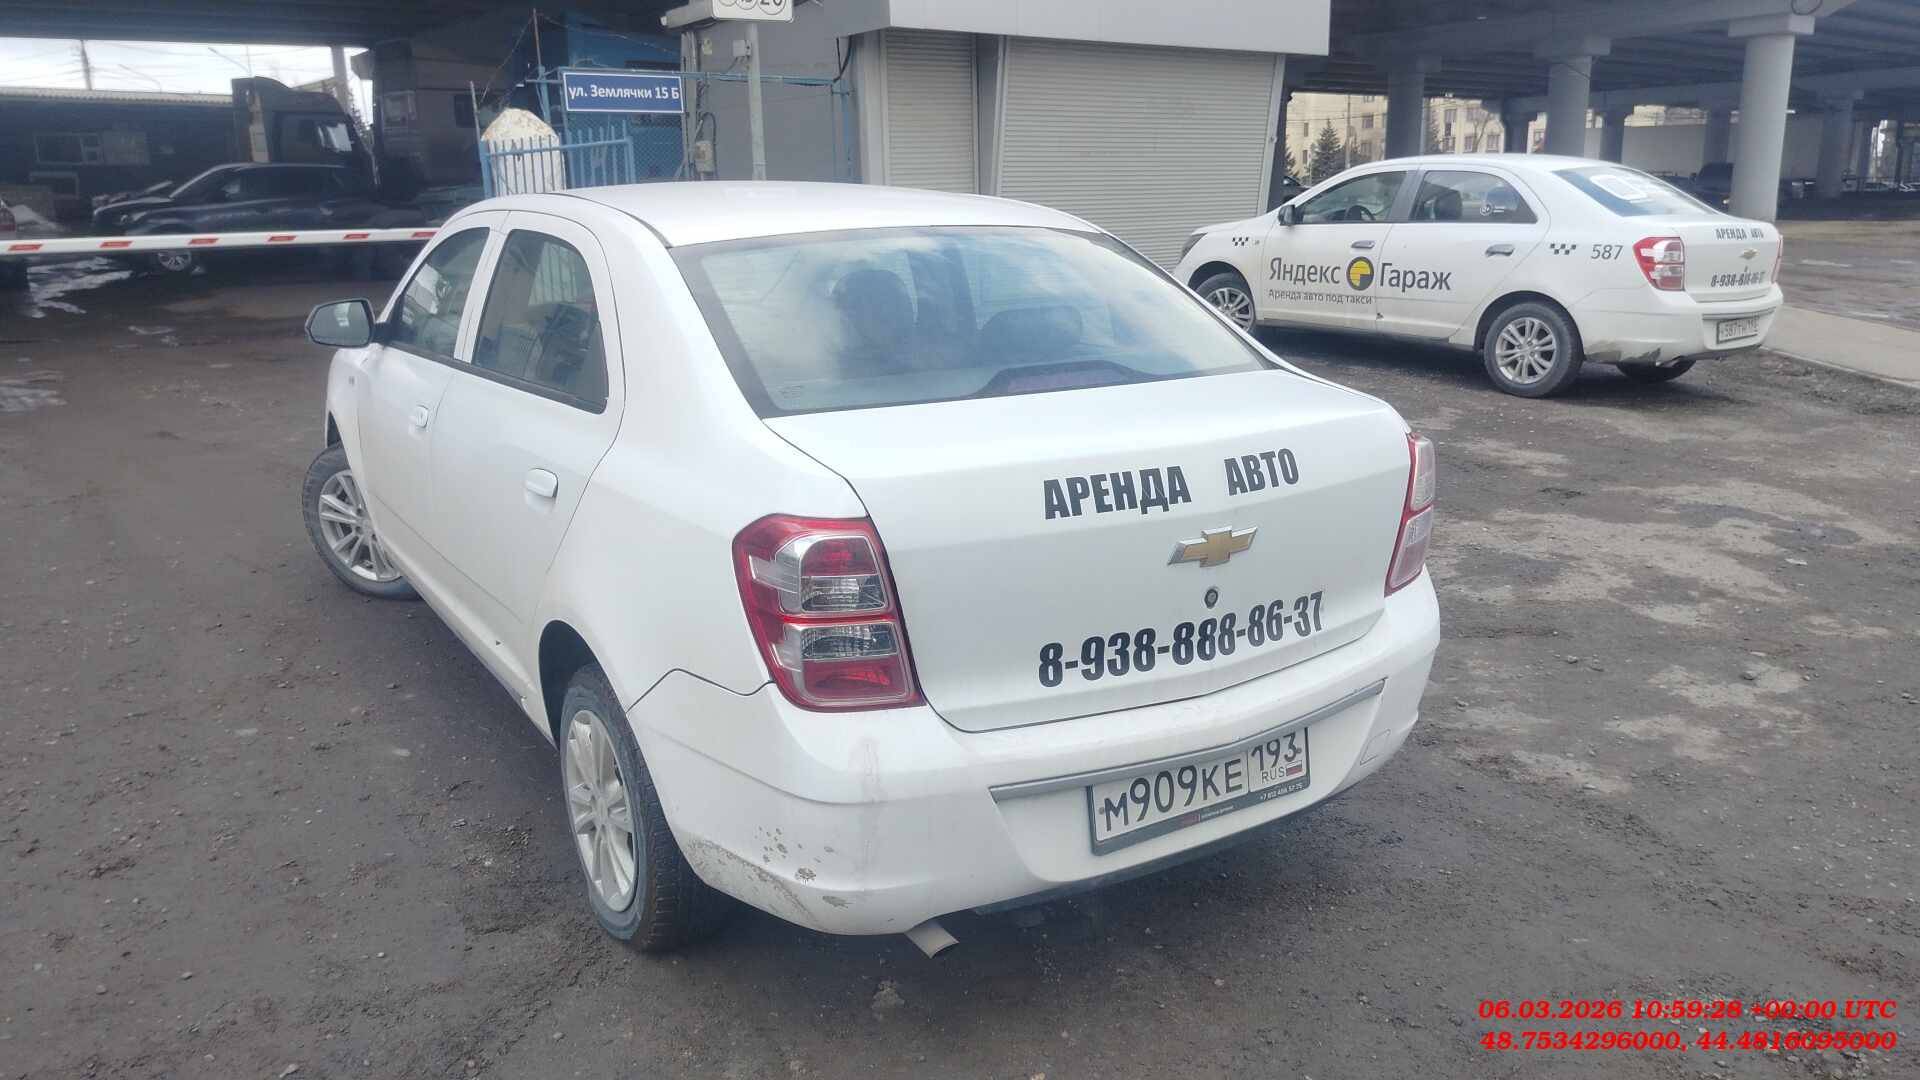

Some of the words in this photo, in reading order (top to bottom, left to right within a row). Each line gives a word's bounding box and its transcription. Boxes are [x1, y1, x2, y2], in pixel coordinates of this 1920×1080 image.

[568, 87, 587, 99] ул.
[590, 85, 652, 98] Землячки
[655, 86, 669, 99] 15
[671, 87, 680, 99] Б
[1715, 228, 1747, 240] АРЕНДА
[1590, 244, 1623, 260] 587
[1269, 257, 1341, 286] Яндекс
[1379, 262, 1452, 293] Гараж
[1269, 289, 1301, 301] Аренда
[1302, 291, 1324, 302] авто
[1326, 293, 1344, 304] под
[1346, 295, 1372, 304] такси
[1043, 465, 1192, 520] АРЕНДА
[1223, 448, 1300, 496] АВТО
[1038, 590, 1324, 688] 8-938-888-86-37
[1103, 758, 1243, 832] М909КЕ
[1251, 731, 1298, 771] 193
[1261, 766, 1285, 784] RUS
